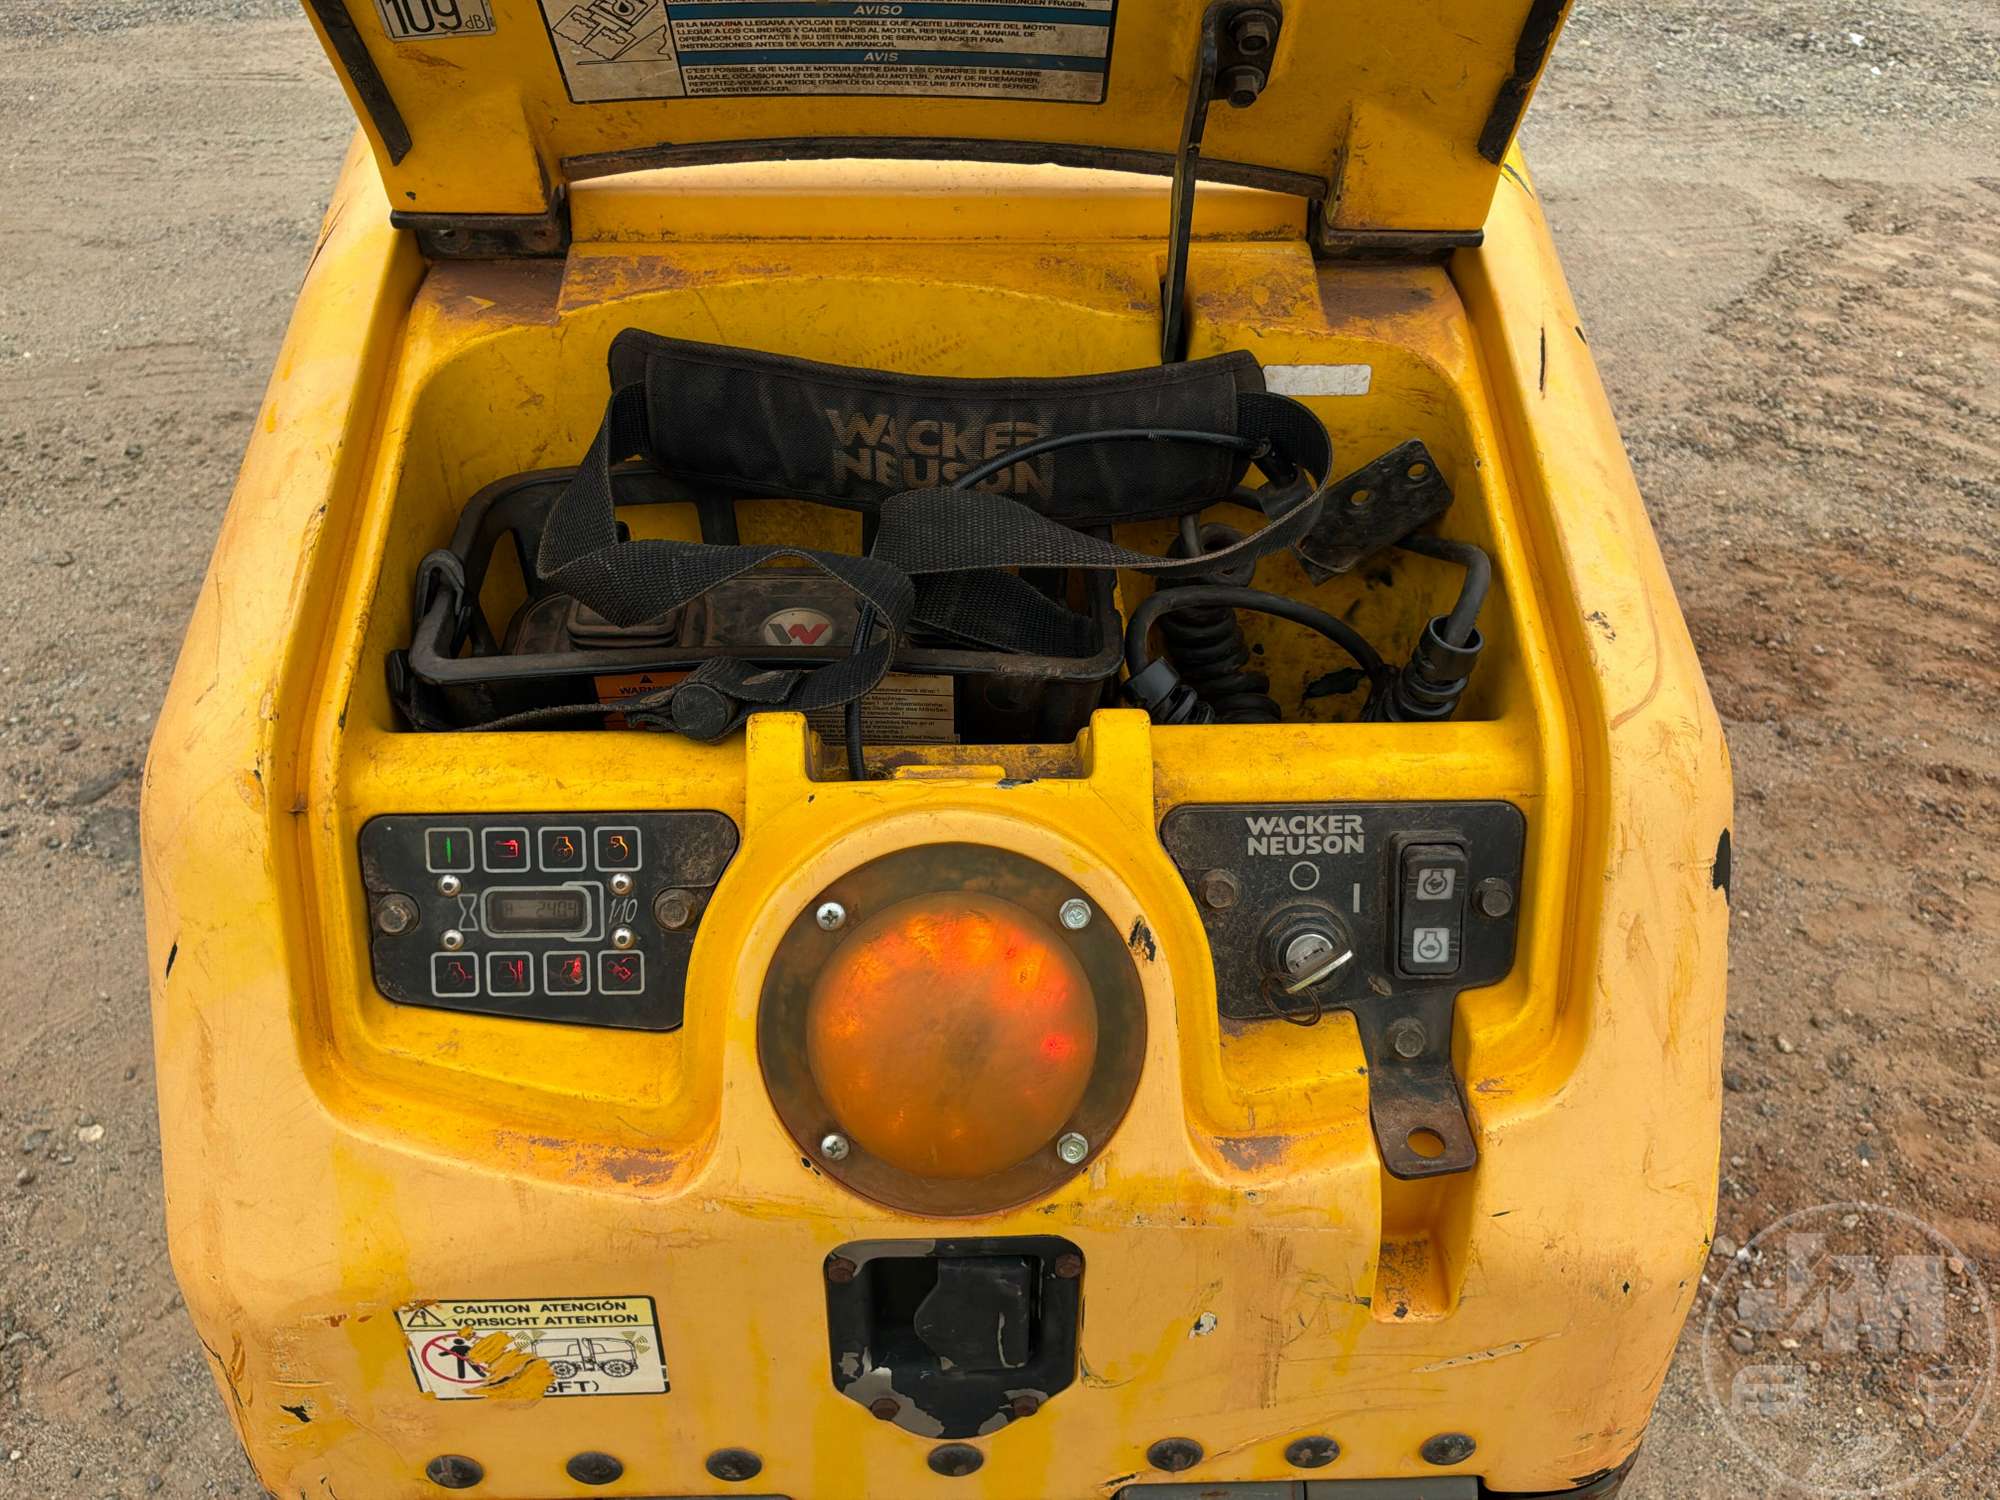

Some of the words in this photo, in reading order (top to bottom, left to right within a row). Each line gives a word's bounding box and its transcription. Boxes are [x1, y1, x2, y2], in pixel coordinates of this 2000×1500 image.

[854, 5, 902, 15] AVISO
[465, 14, 485, 29] dB
[864, 52, 899, 62] AVIS
[1245, 815, 1364, 835] WACKER
[1247, 835, 1364, 856] NEUSON
[452, 1304, 531, 1315] CAUTION
[540, 1300, 627, 1312] ATENCIÓN
[452, 1317, 543, 1327] VORSICHT
[544, 1314, 638, 1325] ATTENTION
